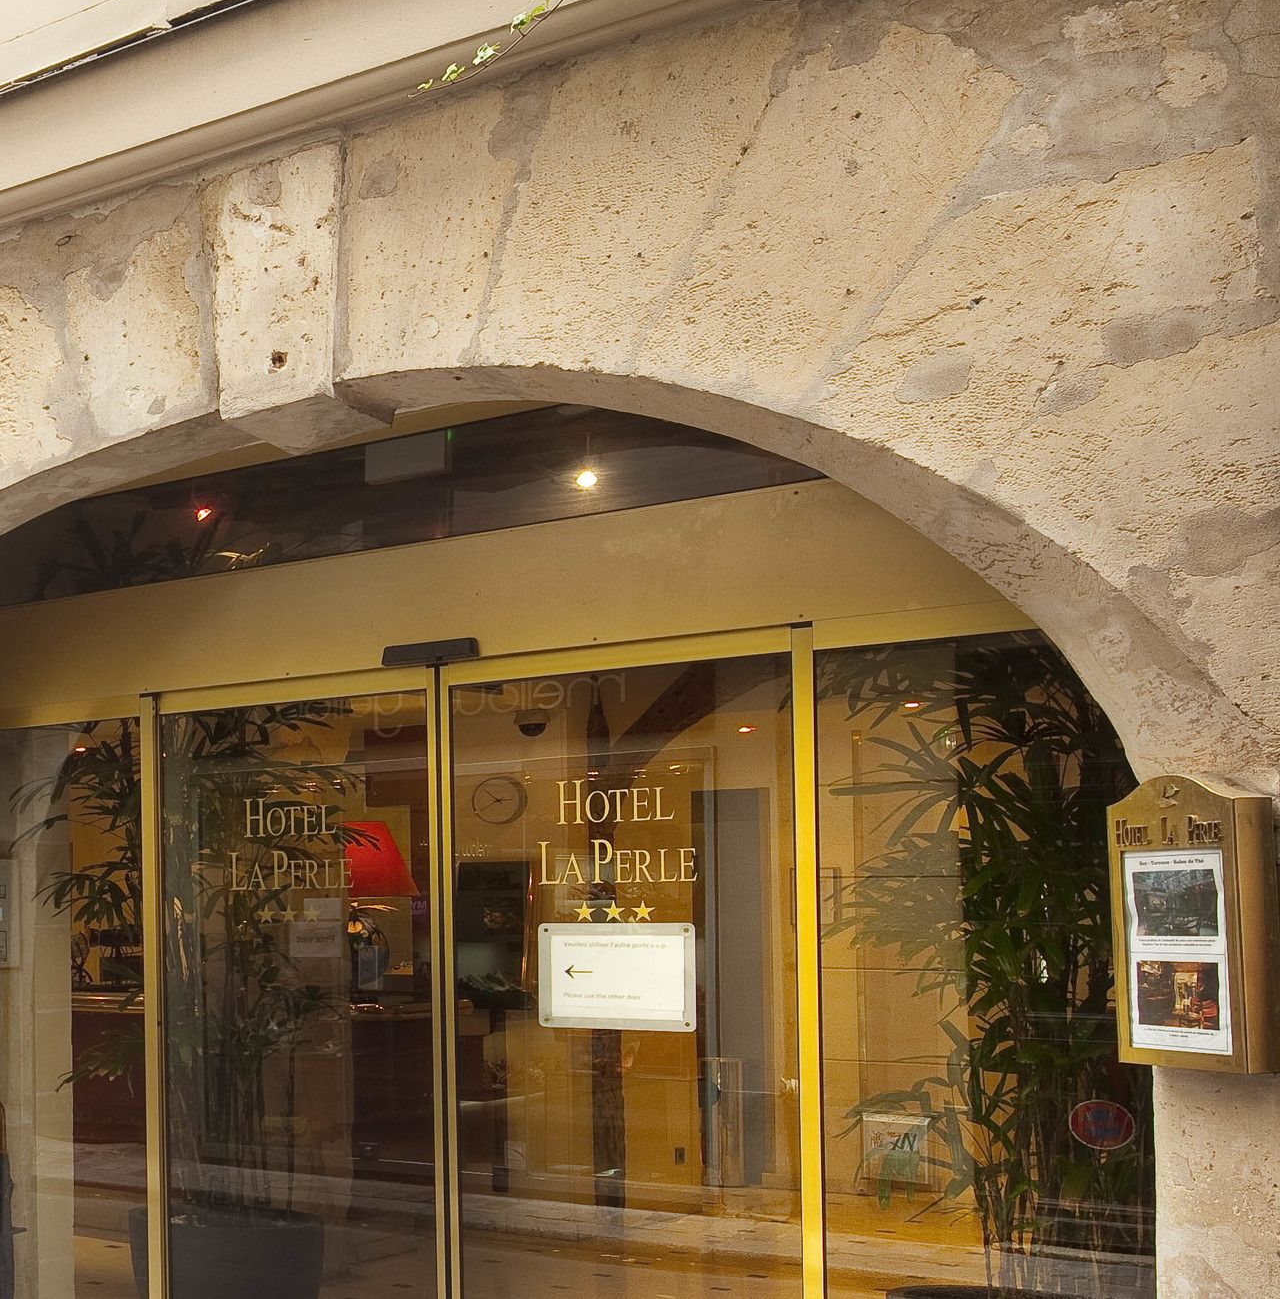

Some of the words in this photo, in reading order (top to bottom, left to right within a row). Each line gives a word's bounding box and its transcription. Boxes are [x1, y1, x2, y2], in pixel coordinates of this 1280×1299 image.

[243, 798, 338, 839] HOTEL
[555, 779, 676, 825] HOTEL
[1115, 817, 1152, 847] HOTEL
[1161, 815, 1179, 845] LA
[1186, 814, 1223, 845] PERLE
[228, 851, 268, 891] LA
[270, 849, 355, 891] PERLE
[537, 841, 586, 886] LA
[590, 838, 699, 885] PERLE
